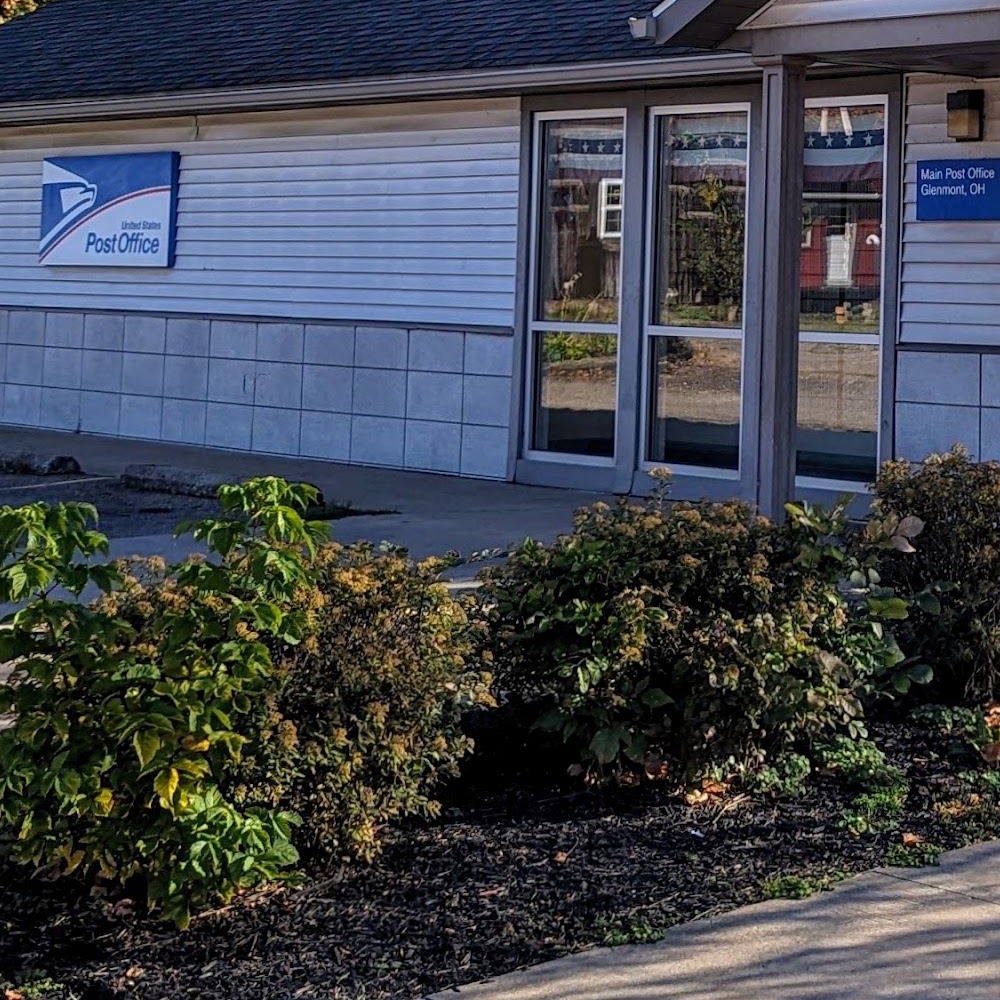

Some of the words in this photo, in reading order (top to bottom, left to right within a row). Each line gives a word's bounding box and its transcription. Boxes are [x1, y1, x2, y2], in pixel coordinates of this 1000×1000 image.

[920, 168, 943, 180] Main
[945, 167, 966, 180] Post
[967, 166, 995, 179] Office
[920, 183, 968, 197] Glenmont,
[969, 182, 986, 195] OH
[121, 220, 142, 231] United
[142, 220, 162, 231] States
[85, 232, 118, 254] Post
[118, 232, 160, 255] Office
